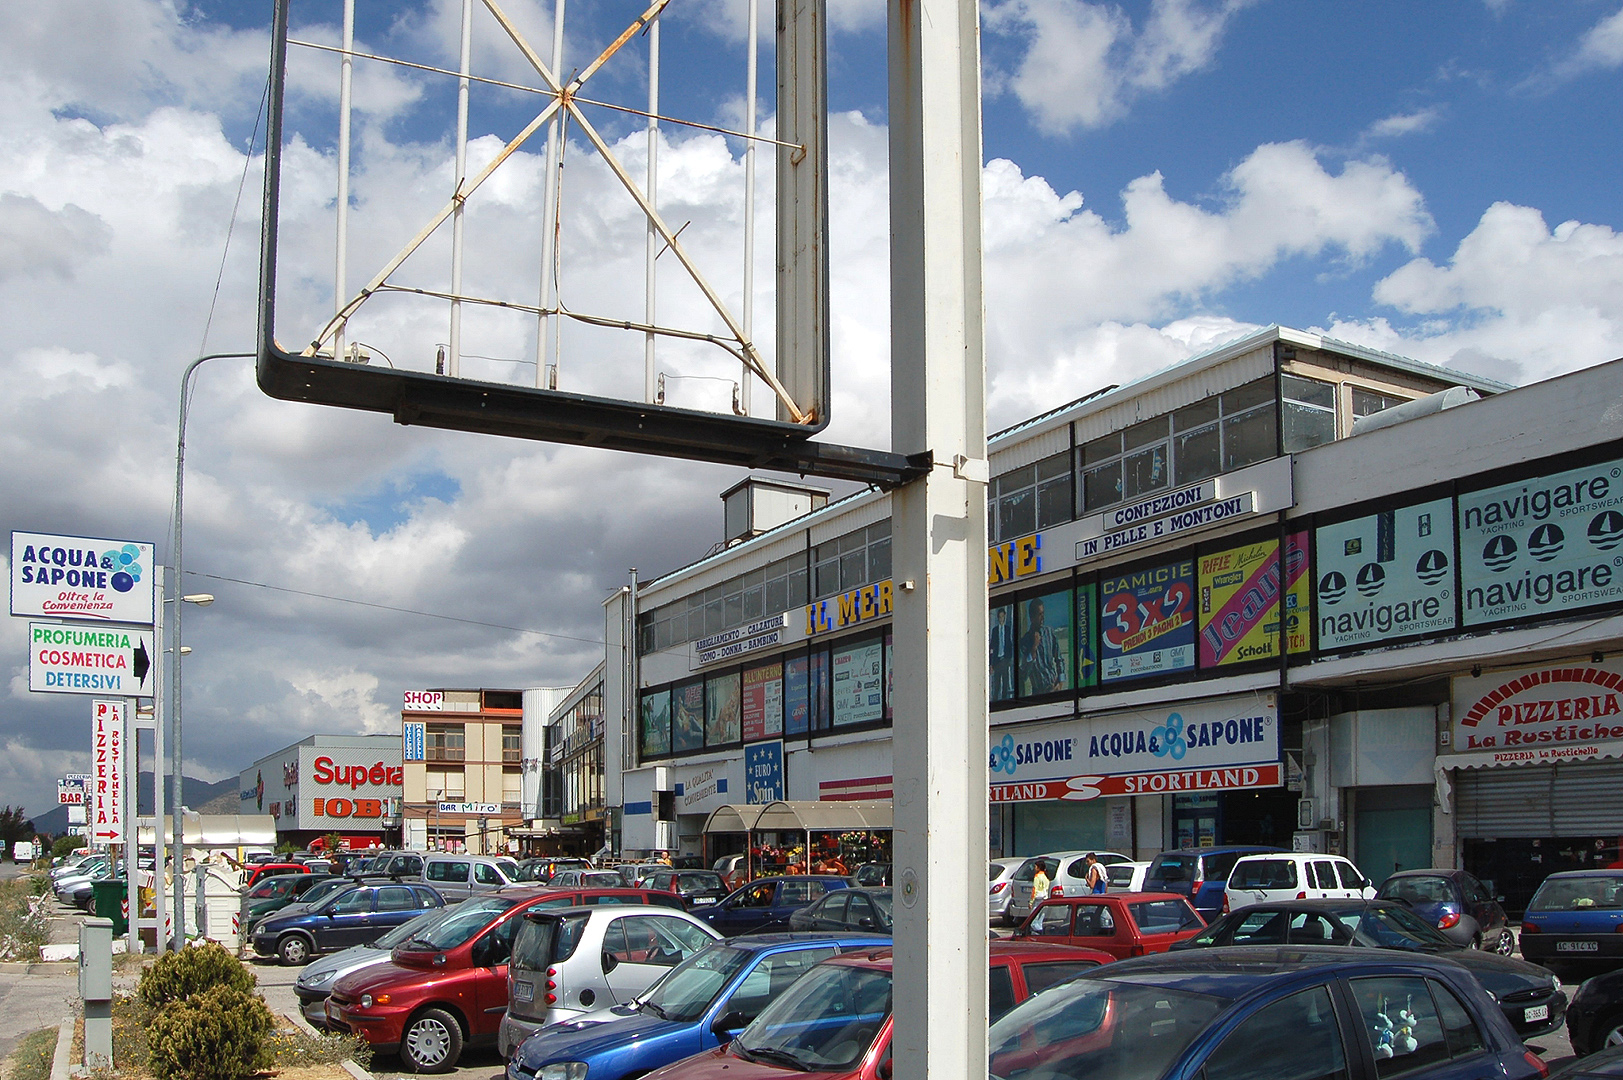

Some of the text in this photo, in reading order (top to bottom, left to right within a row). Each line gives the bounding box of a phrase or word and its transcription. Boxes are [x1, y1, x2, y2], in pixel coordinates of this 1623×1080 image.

[1115, 487, 1202, 524] CONFEZIONI
[1465, 476, 1609, 530] navigare
[1084, 498, 1242, 555] IN PELLE E MONTONI
[1481, 519, 1525, 535] YACHTING
[22, 545, 114, 569] ACQUA &
[1202, 555, 1231, 575] RIFLE
[22, 565, 107, 589] SAPONE
[1103, 562, 1192, 595] CAMICIE
[1213, 572, 1242, 585] Wrangler
[1467, 564, 1612, 610] navigare
[42, 600, 113, 610] Convenienza
[58, 591, 104, 601] Oltre la
[1482, 586, 1623, 617] YACHTING SPORTSWEA
[806, 601, 831, 635] IL
[1102, 582, 1193, 650] 3x2
[1322, 596, 1440, 636] navigare
[33, 628, 131, 648] PROFUMERIA
[696, 629, 740, 650] ABBIGLIAMENTO
[747, 615, 784, 634] CALZATURE
[1335, 616, 1454, 642] YACHTING SPORTSWEAR
[721, 643, 743, 656] DONNA
[748, 633, 778, 650] BAMBINO
[1237, 642, 1272, 660] Schott
[39, 649, 126, 669] COSMETICA
[45, 671, 121, 690] DETERSIVI
[404, 691, 441, 704] SHOP
[1498, 693, 1621, 726] PIZZERIA
[1089, 717, 1264, 758] ACQUA & SAPONE
[1467, 734, 1496, 749] La
[97, 704, 107, 824] PIZZERIA
[1016, 739, 1072, 765] SAPONE
[1494, 747, 1598, 762] PIZZERIA La Rustichella
[111, 705, 119, 824] LA RUSTICHELLA
[755, 763, 771, 778] EURO
[753, 780, 775, 804] Spin
[1124, 768, 1259, 793] SPORTLAND
[61, 793, 82, 803] BAR
[440, 803, 457, 811] BAR
